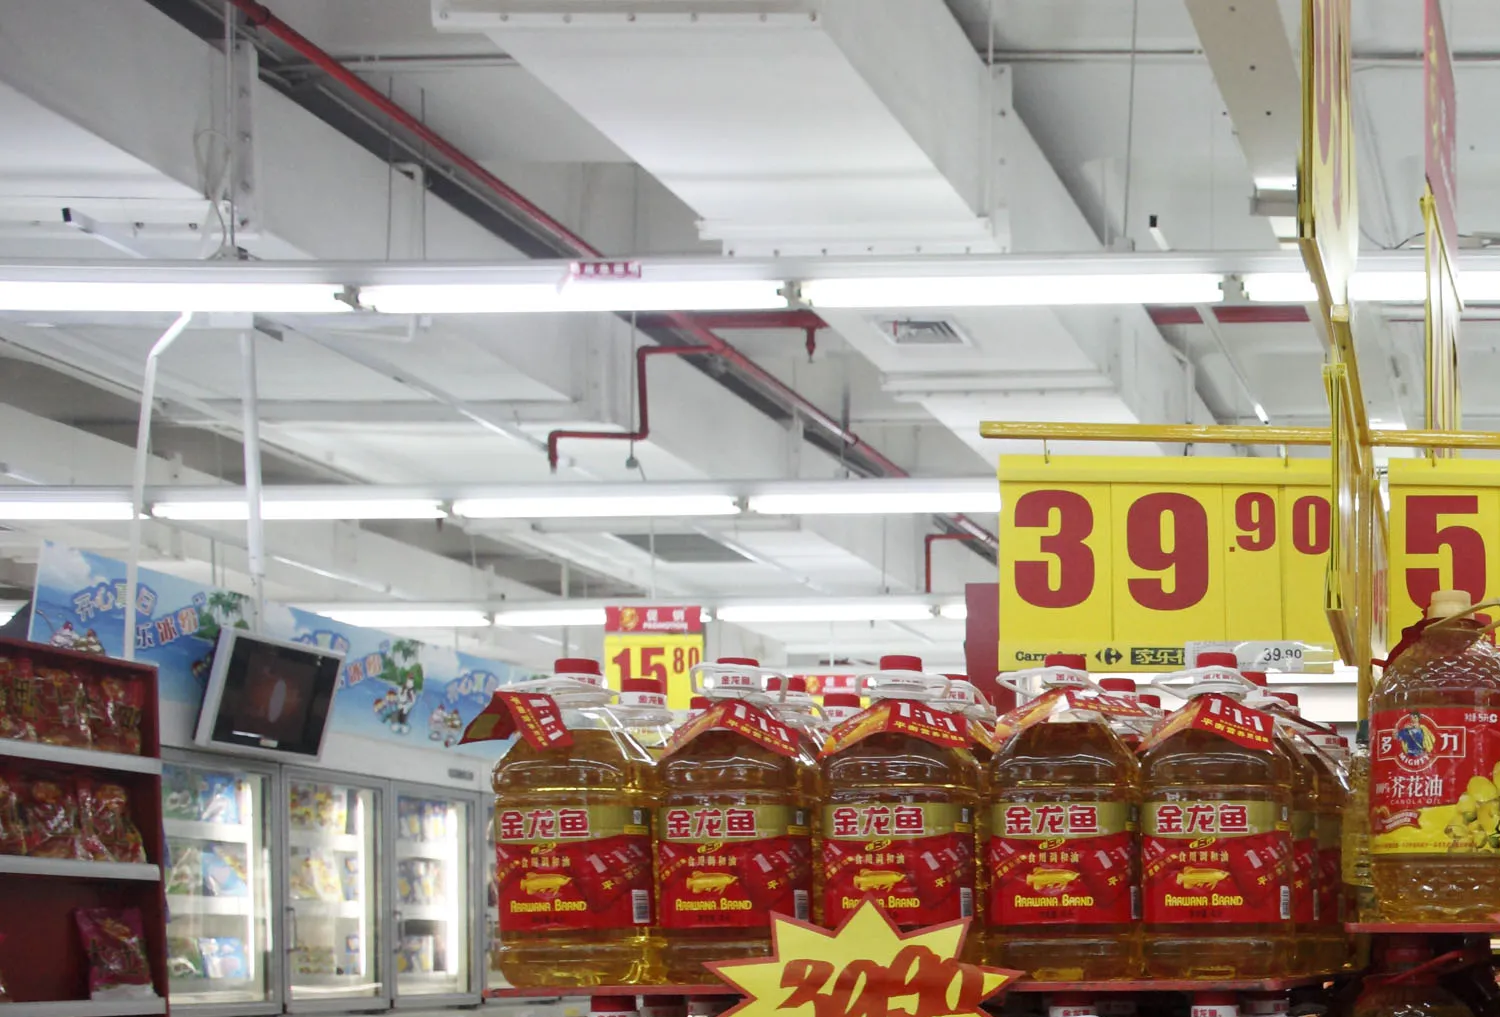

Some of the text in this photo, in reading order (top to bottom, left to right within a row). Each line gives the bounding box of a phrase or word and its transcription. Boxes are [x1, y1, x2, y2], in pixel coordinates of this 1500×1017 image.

[1014, 488, 1332, 612] 39.90
[1262, 647, 1303, 662] 39.90
[733, 703, 790, 743] 1:1:1
[898, 702, 956, 732] 1:1:1
[1208, 697, 1264, 733] 1:1:1
[1397, 751, 1430, 770] MIGHTY
[500, 808, 592, 840] 金龙鱼
[666, 807, 758, 839] 金龙鱼
[831, 804, 925, 837] 金龙鱼
[1004, 804, 1100, 835] 金龙鱼
[1156, 804, 1250, 835] 金龙鱼
[554, 899, 587, 912] BRAND
[719, 898, 753, 911] BRAND
[888, 896, 920, 909] BRAND
[1061, 893, 1094, 906] BRAND
[1211, 893, 1244, 906] BRAND
